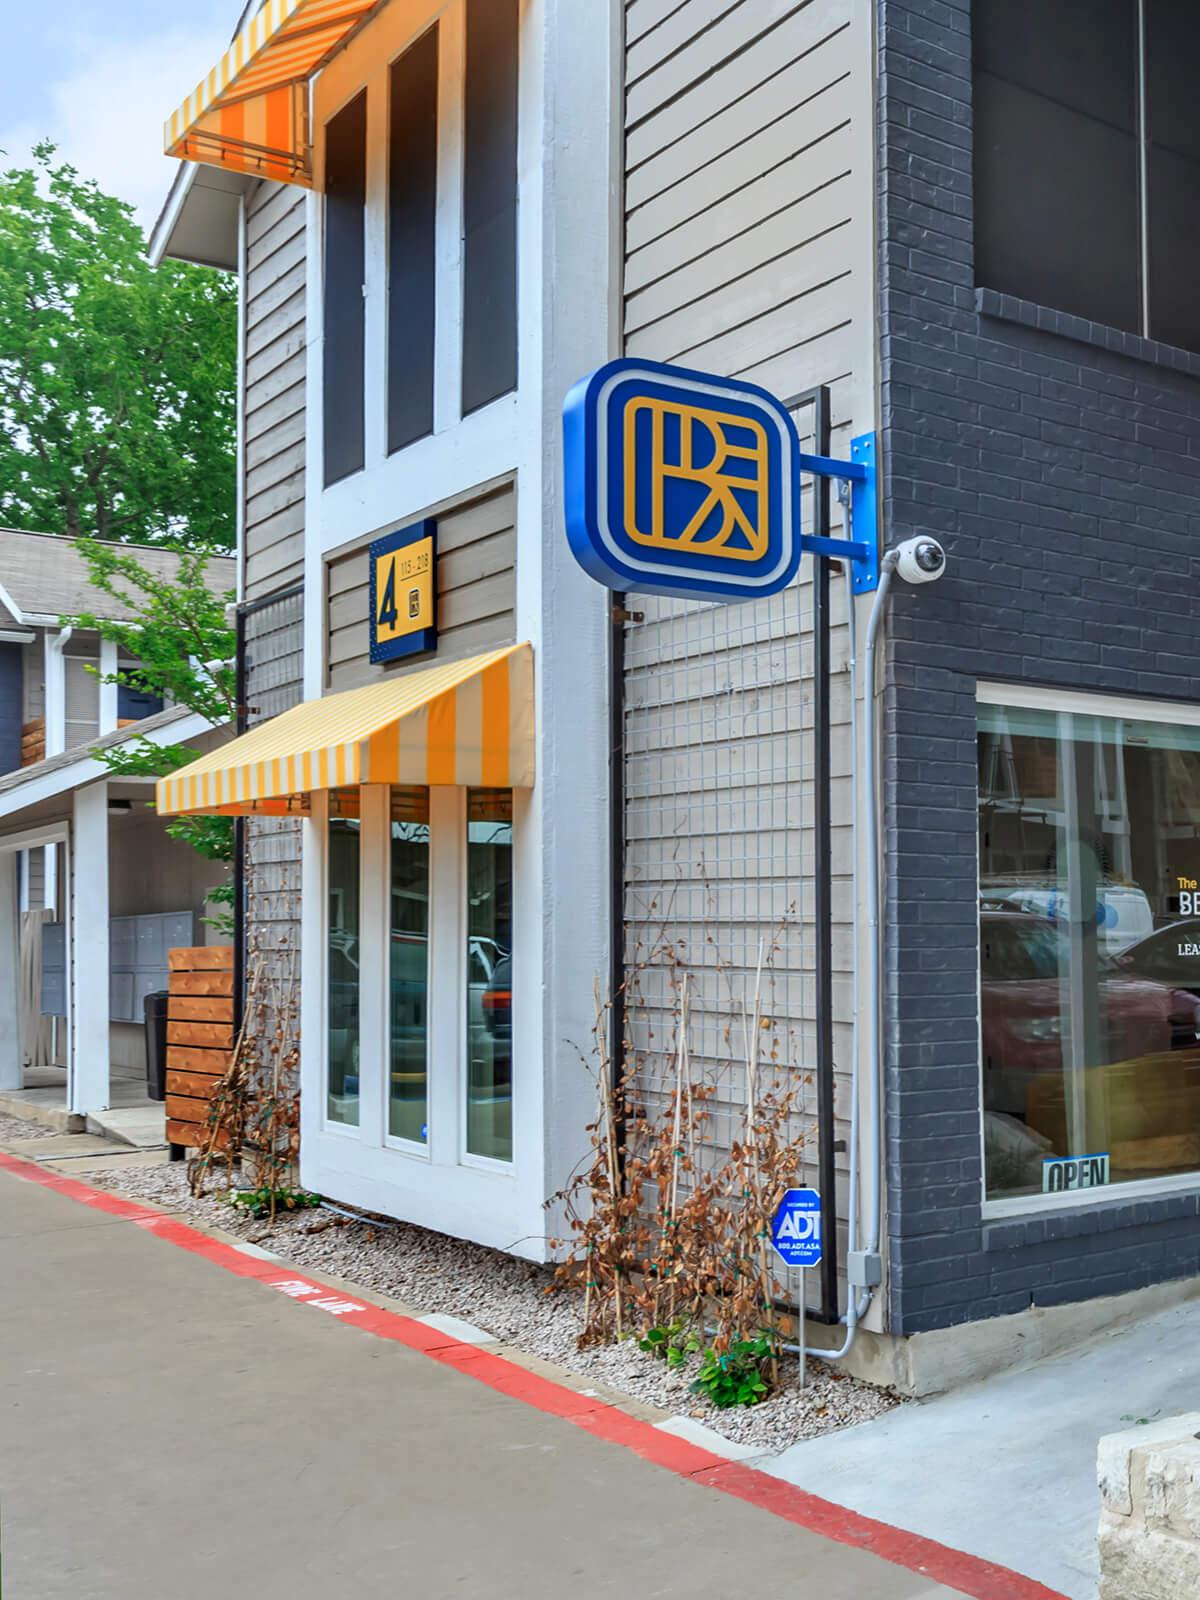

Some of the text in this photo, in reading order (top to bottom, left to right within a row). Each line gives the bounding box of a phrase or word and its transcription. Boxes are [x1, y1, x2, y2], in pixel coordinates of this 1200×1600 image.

[377, 556, 398, 631] 4
[1177, 877, 1197, 888] The
[1049, 1157, 1105, 1192] OPEN
[776, 1210, 821, 1240] ADT
